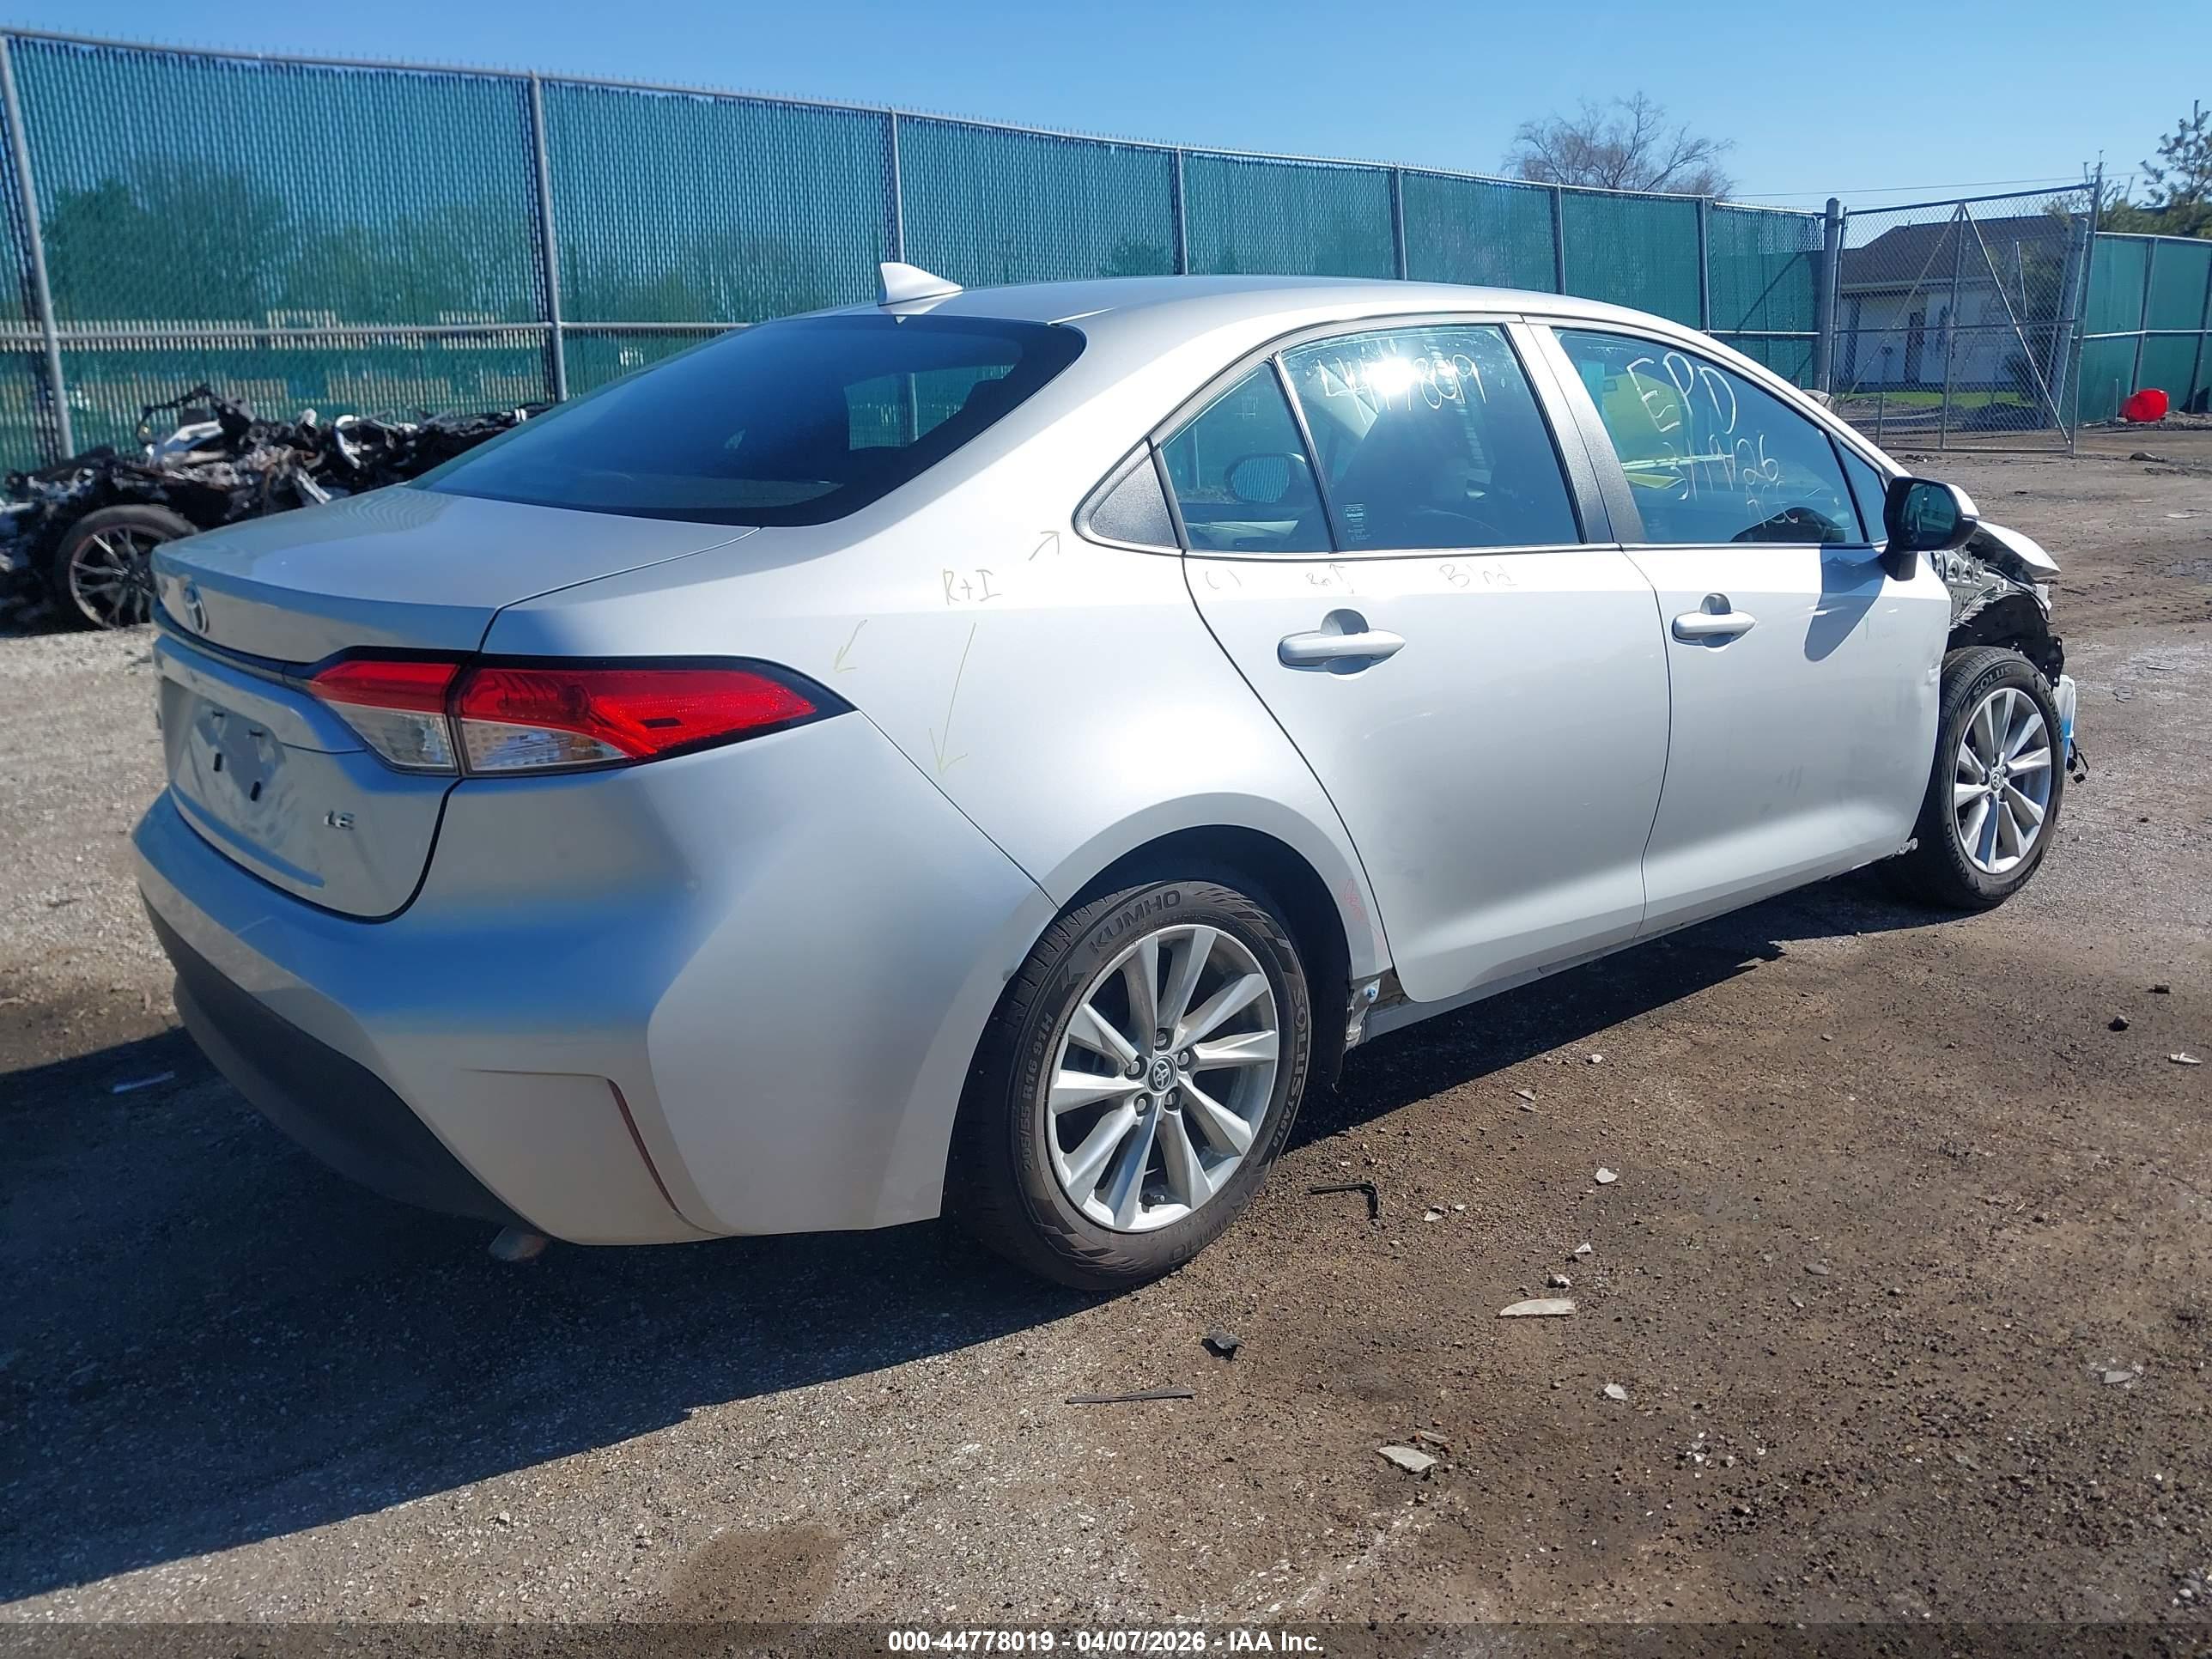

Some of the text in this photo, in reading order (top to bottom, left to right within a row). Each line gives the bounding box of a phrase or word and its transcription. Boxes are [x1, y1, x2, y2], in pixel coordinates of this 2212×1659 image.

[1627, 352, 1736, 434] EPD
[2042, 685, 2063, 743] KUMHO
[324, 809, 355, 831] LE
[1091, 889, 1182, 955] KUMHO
[1291, 989, 1308, 1097] SOLUS
